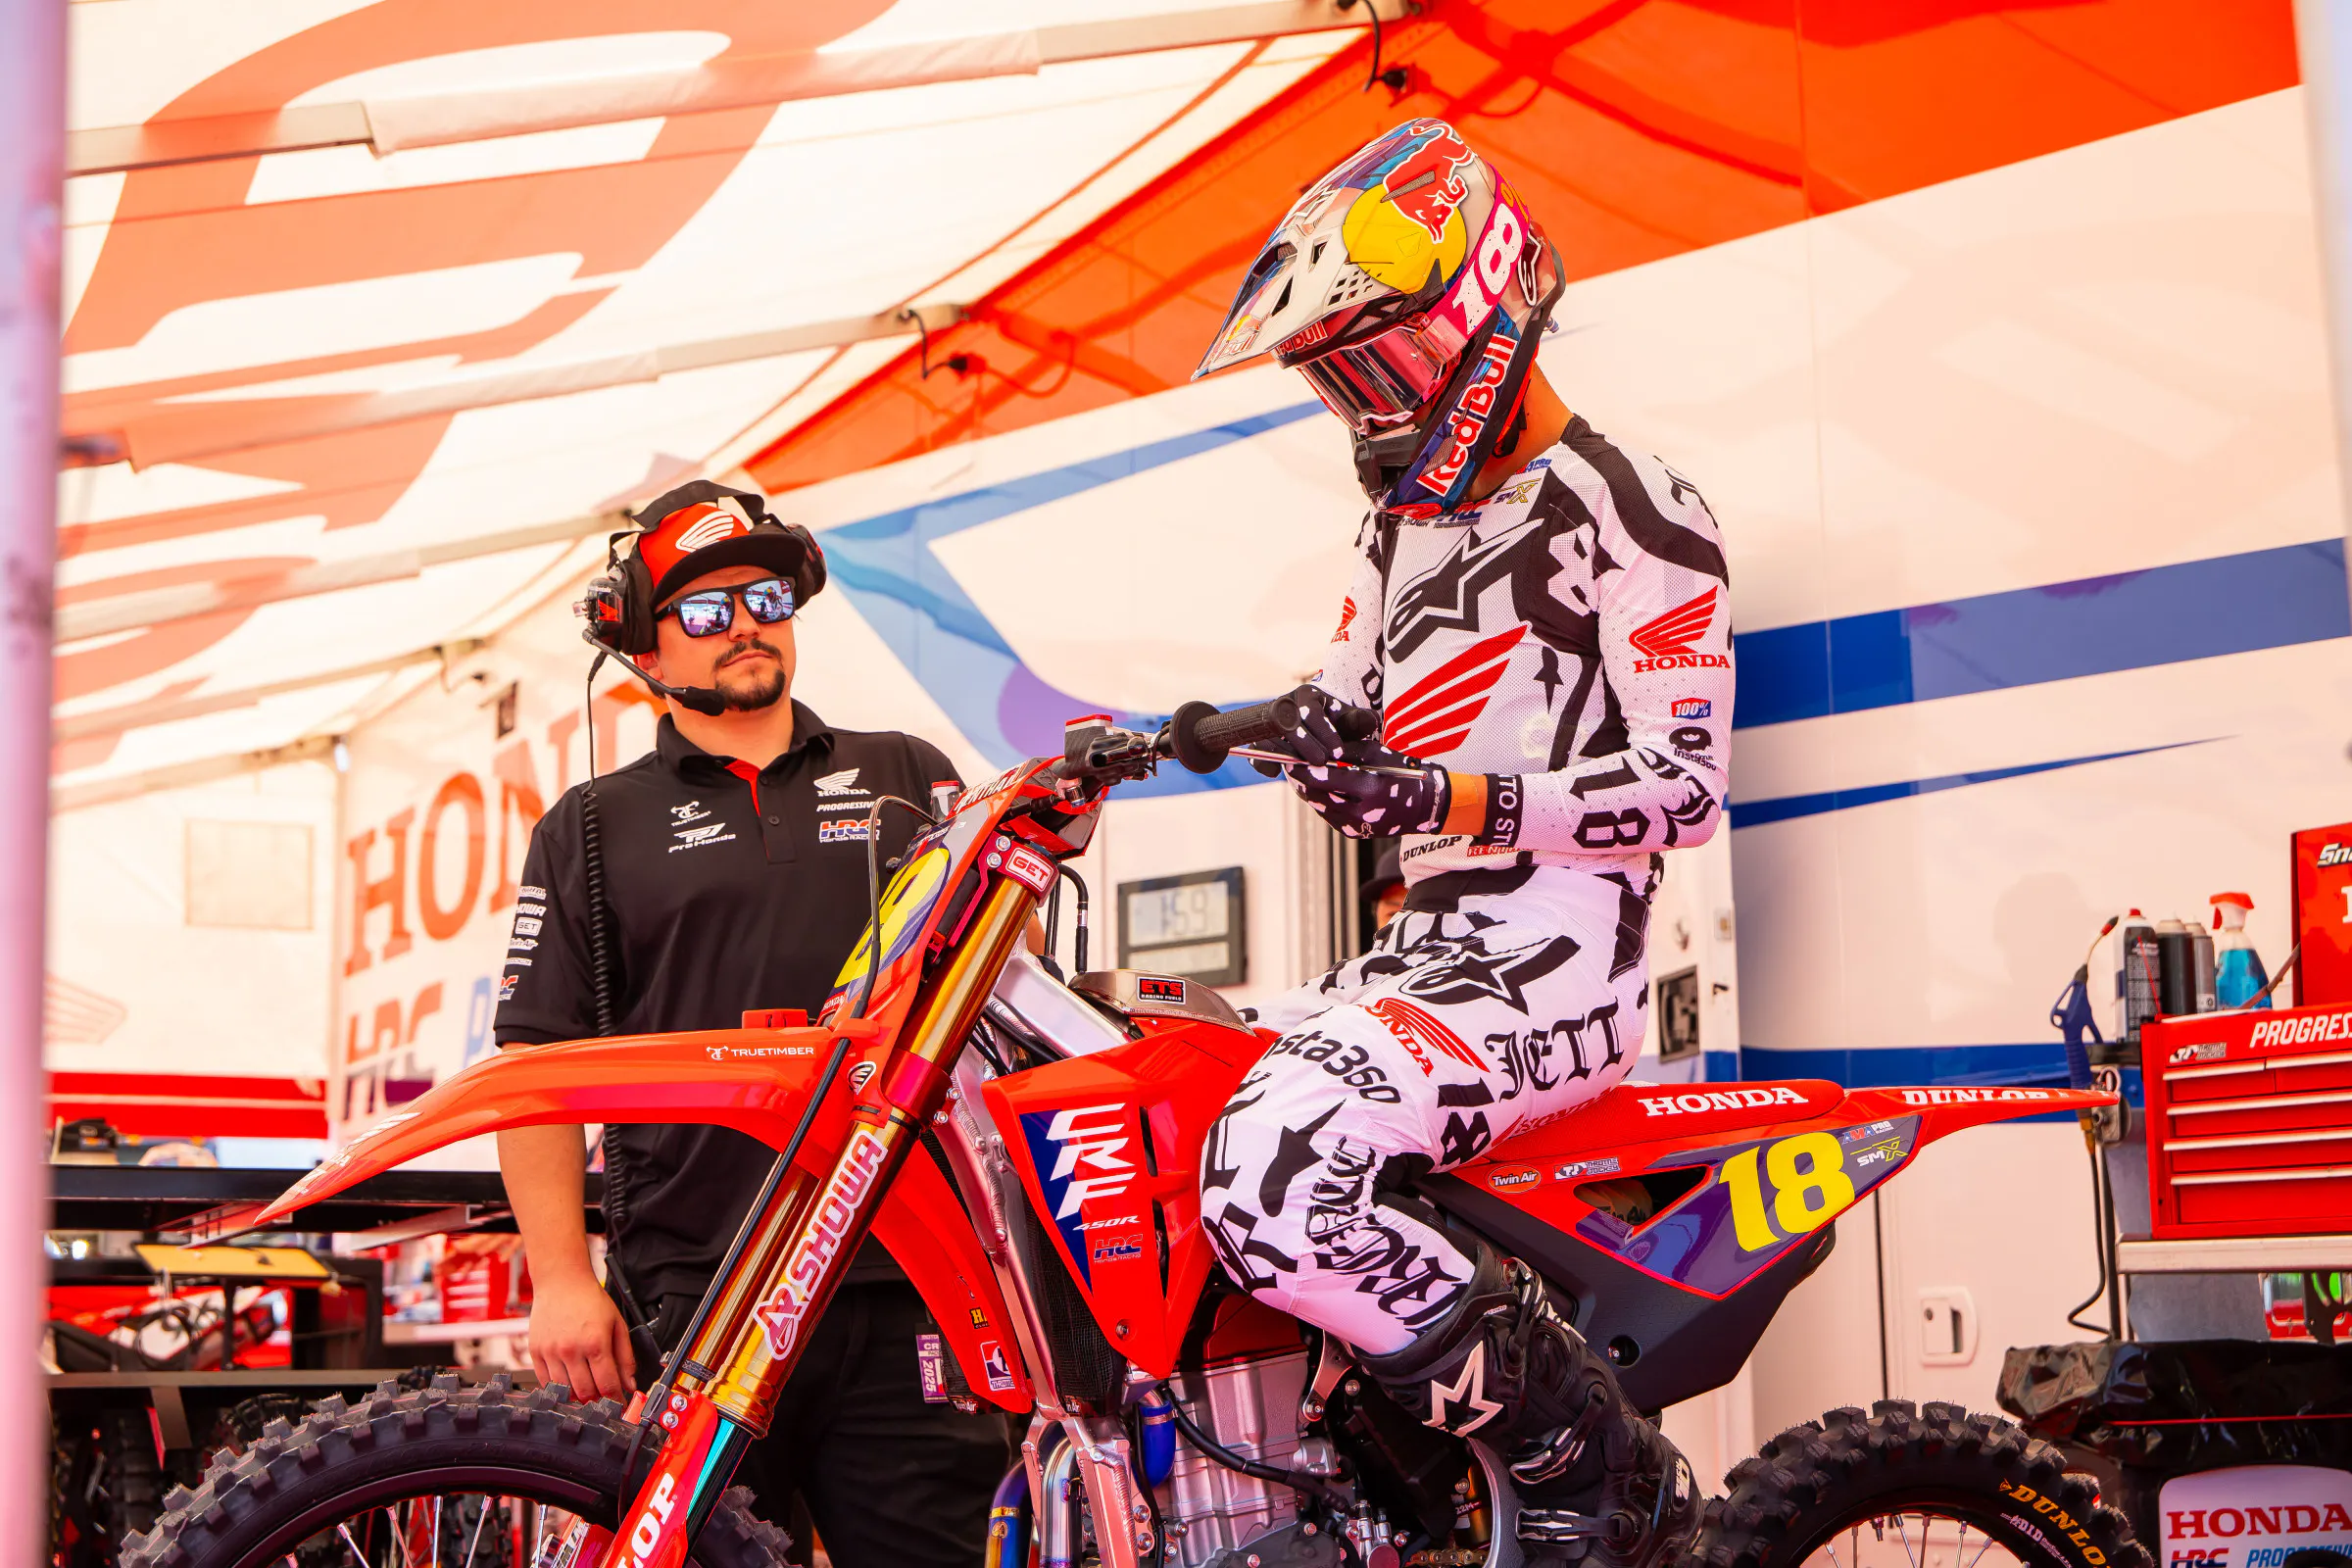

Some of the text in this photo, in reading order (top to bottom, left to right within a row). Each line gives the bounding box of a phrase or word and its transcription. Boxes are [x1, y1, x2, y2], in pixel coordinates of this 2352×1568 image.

[1633, 654, 1731, 673] HONDA
[1675, 700, 1709, 717] 100%
[816, 802, 877, 811] PROGRESSIV
[1403, 835, 1463, 862] DUNLOP
[1012, 855, 1050, 882] GET
[517, 921, 538, 931] GET
[1141, 980, 1183, 996] ETS
[731, 1047, 814, 1056] TRUETIMBER
[1358, 1004, 1435, 1078] ONDA
[1484, 996, 1624, 1103] JETT
[1262, 1030, 1401, 1103] nsta360
[1638, 1087, 1809, 1117] HONDA
[1901, 1089, 2050, 1106] DUNLOP
[1842, 1125, 1875, 1145] AMA
[1046, 1102, 1137, 1222] CRF
[1587, 1158, 1618, 1167] THROTTLE
[1493, 1172, 1538, 1187] Twin Air
[1718, 1132, 1855, 1252] 18
[789, 1130, 887, 1299] SHOWA
[1072, 1215, 1141, 1232] 450R
[1094, 1233, 1144, 1260] HRC
[922, 1359, 937, 1393] 2025
[2009, 1484, 2113, 1568] DUNLO
[2166, 1503, 2352, 1540] HONDA
